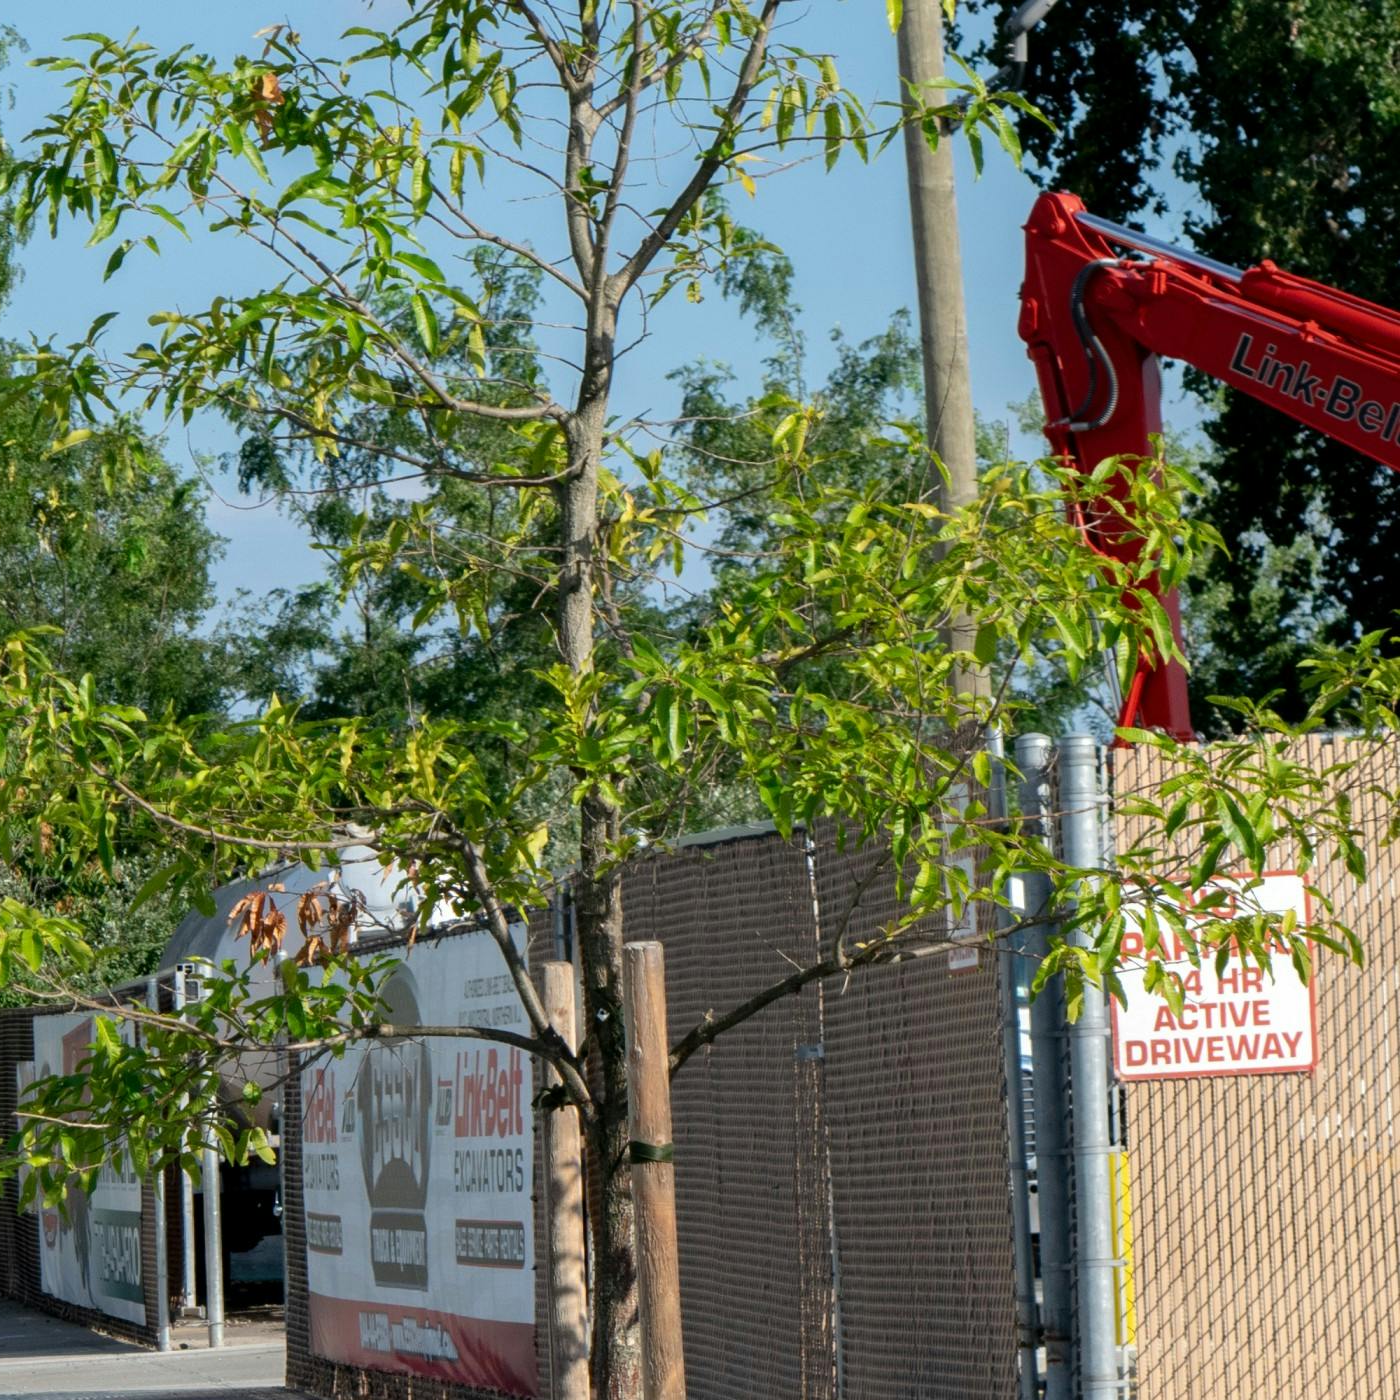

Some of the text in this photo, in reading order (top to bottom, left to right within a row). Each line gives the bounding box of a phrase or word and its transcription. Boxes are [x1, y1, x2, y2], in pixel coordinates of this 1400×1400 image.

[1218, 967, 1263, 995] HR
[1154, 1000, 1270, 1031] ACTIVE
[1125, 1031, 1303, 1067] DRIVEWAY
[455, 1046, 523, 1138] Link-Belt
[454, 1148, 524, 1192] EXCAVATORS
